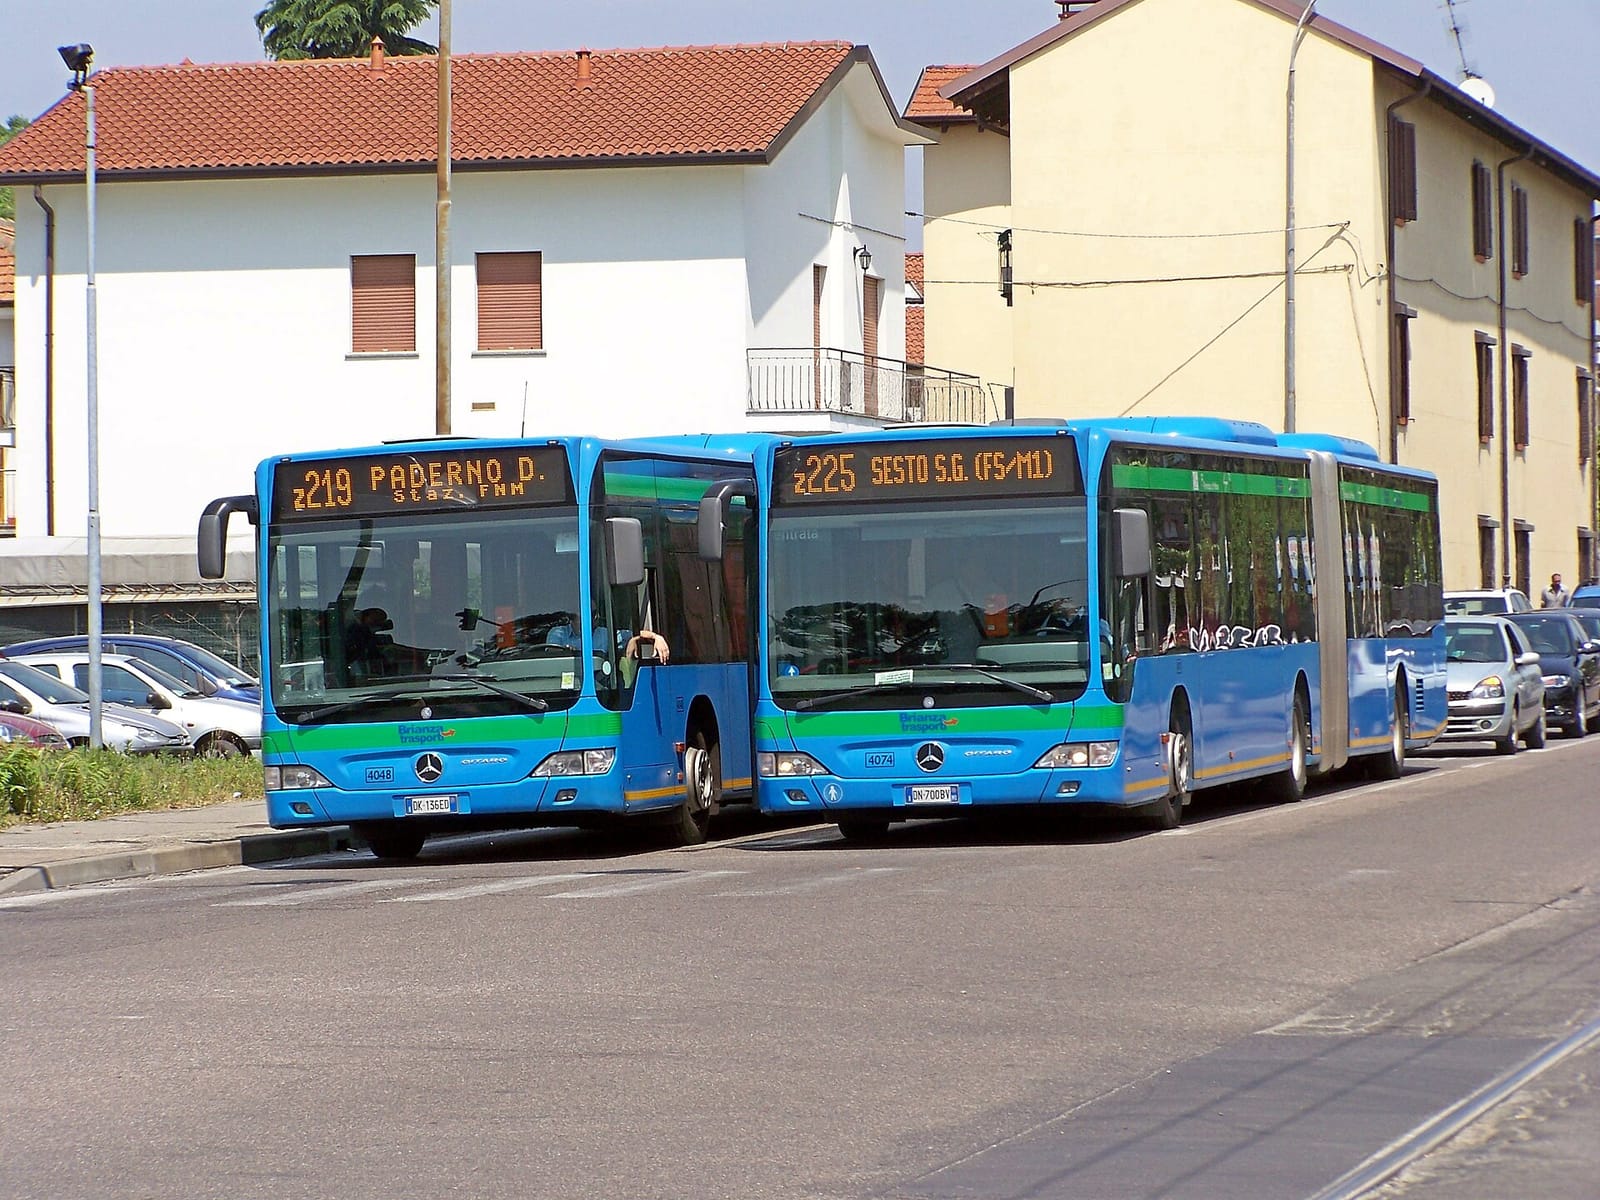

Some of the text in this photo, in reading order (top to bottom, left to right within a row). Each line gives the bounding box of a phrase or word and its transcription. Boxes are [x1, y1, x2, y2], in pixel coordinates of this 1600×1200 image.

[370, 458, 502, 490] PADERNO
[518, 456, 545, 481] D.
[871, 455, 929, 485] SESTO
[935, 453, 968, 483] S.G.
[974, 450, 1053, 482] (FS/M1)
[479, 482, 524, 497] FNM
[900, 712, 946, 723] Brianza
[398, 724, 443, 735] Brianza
[868, 754, 893, 765] 4074
[367, 769, 392, 781] 4048
